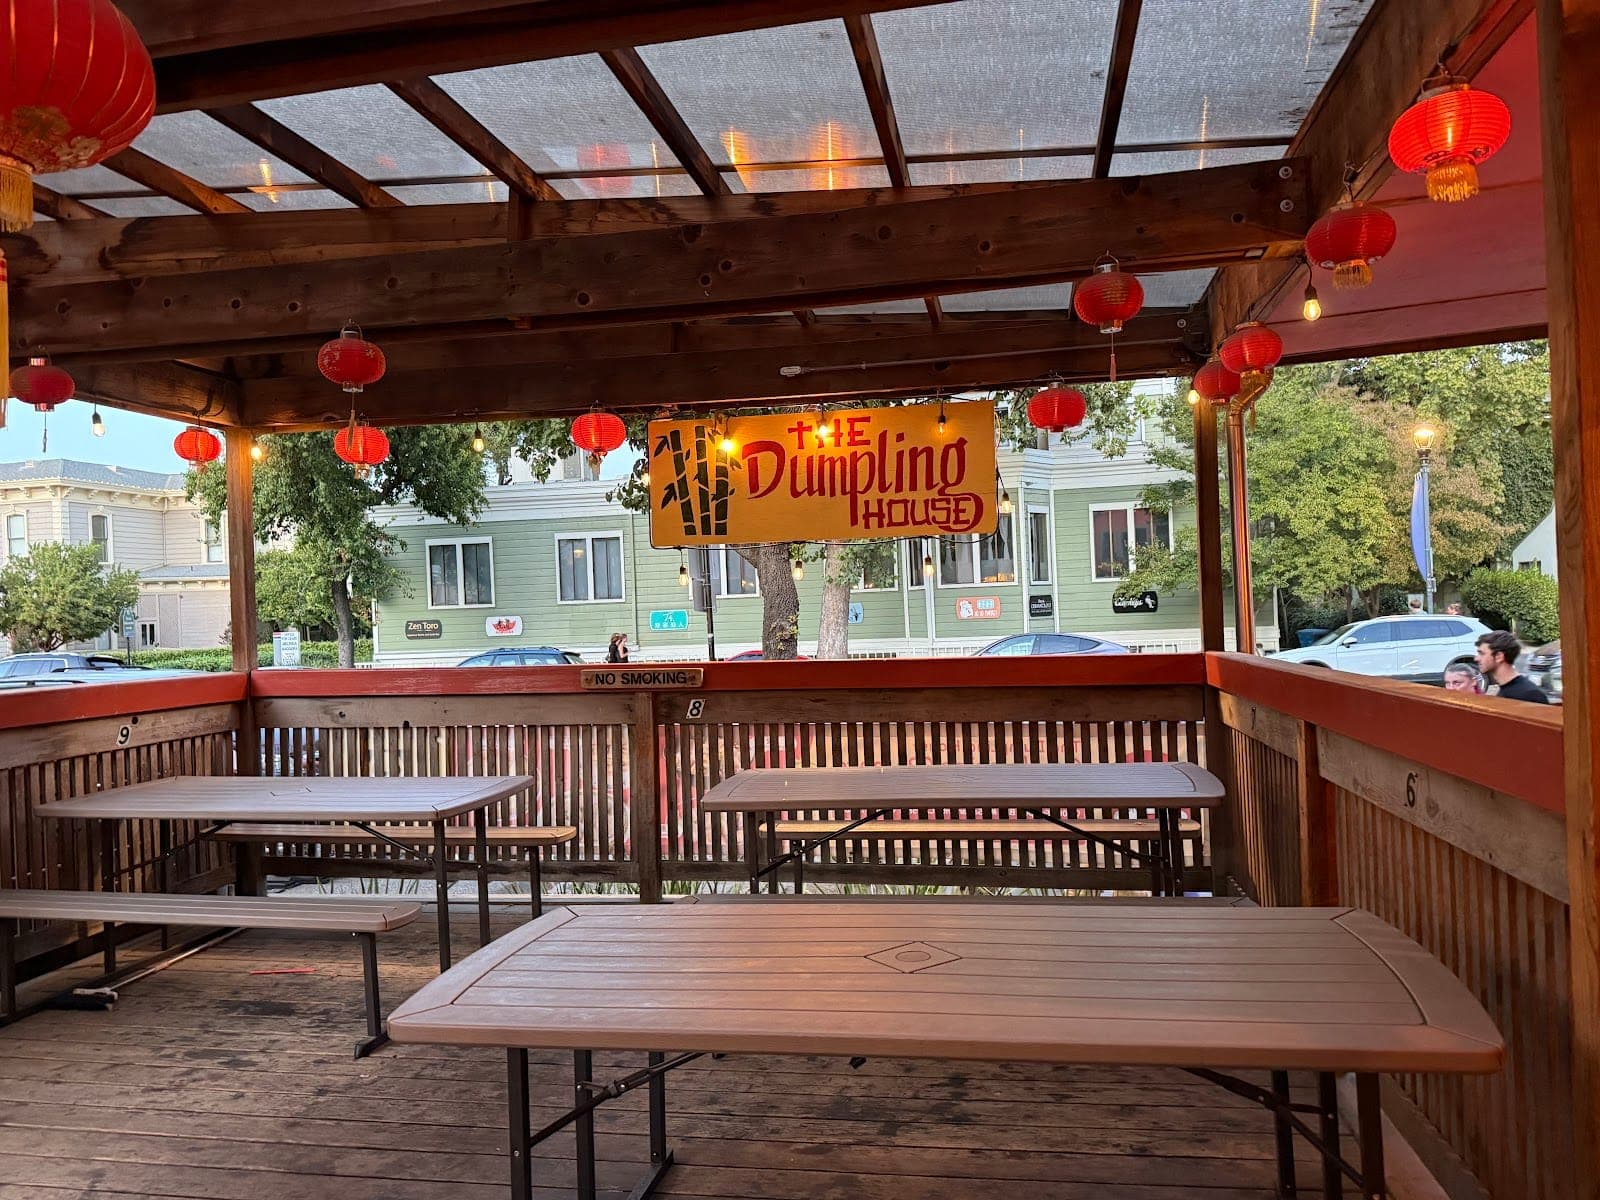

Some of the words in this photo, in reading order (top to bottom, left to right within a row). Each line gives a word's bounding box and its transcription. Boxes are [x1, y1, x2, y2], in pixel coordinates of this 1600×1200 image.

[787, 415, 871, 450] THE
[741, 429, 983, 533] Dumpling
[862, 496, 973, 529] HOUSE
[407, 622, 422, 630] Zen
[422, 622, 439, 630] Toro
[595, 673, 616, 685] NO
[621, 671, 687, 685] SMOKING
[689, 700, 702, 717] 8
[118, 726, 130, 745] 9
[1406, 772, 1416, 808] 6
